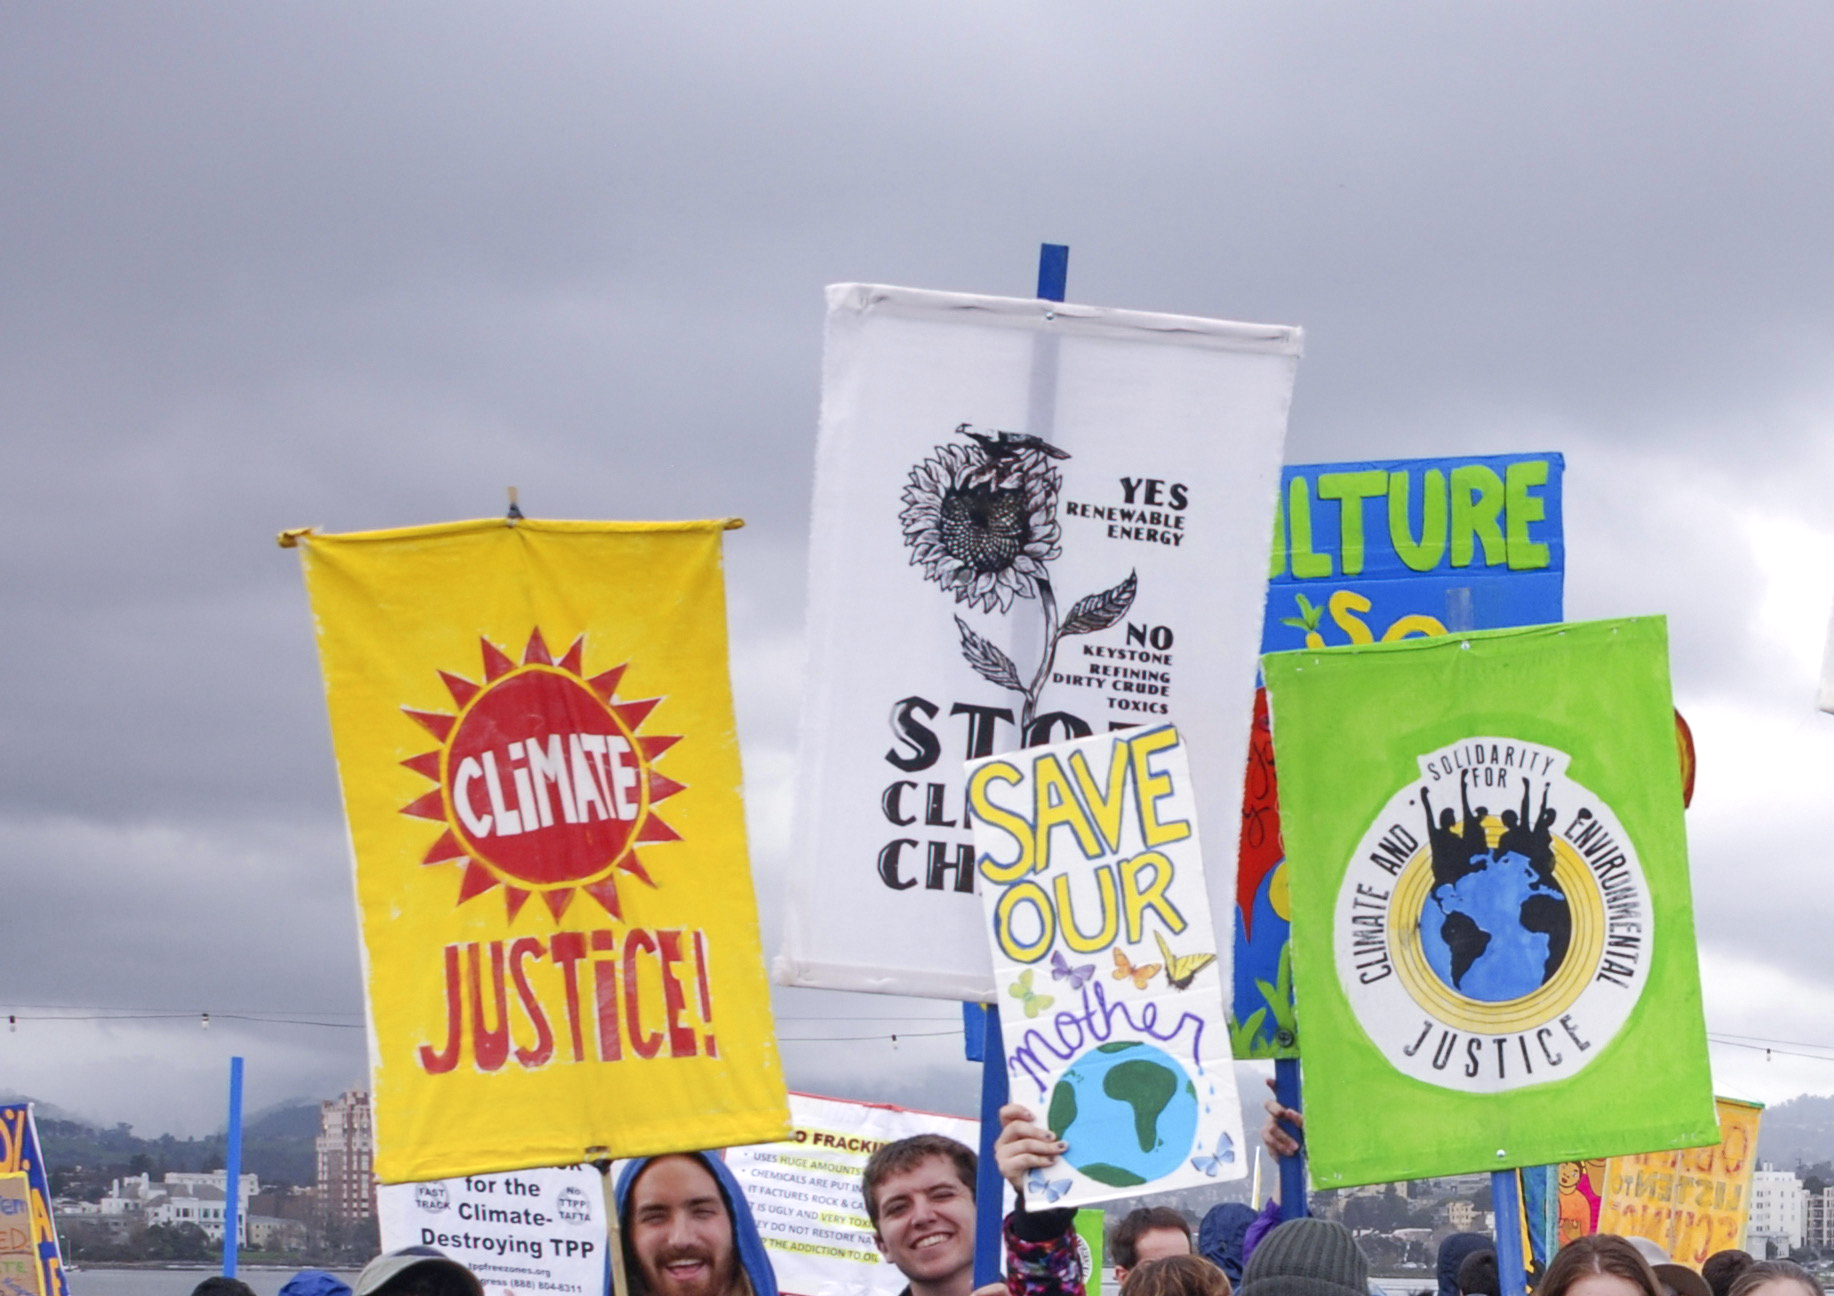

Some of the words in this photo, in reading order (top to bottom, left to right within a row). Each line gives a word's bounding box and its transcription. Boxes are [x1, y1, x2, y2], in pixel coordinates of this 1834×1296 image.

[1120, 477, 1189, 511] YES
[1066, 501, 1186, 530] RENEWABLE
[1107, 525, 1184, 547] ENERGY
[1125, 622, 1174, 651] NO
[1083, 645, 1173, 666] KEYSTONE
[1053, 673, 1104, 688] DIRTY
[1112, 680, 1170, 697] CRUDE
[1090, 664, 1171, 684] REFINING
[1107, 697, 1169, 714] TOXICS
[1428, 744, 1555, 781] SOLIDARITY
[454, 732, 643, 837] CLIMATE
[1472, 767, 1508, 788] FOR
[968, 723, 1191, 885] SAVE
[1371, 823, 1419, 876] AND
[994, 850, 1188, 963] OUR
[1563, 817, 1641, 989] ENVIRONMENTAL
[1351, 883, 1392, 986] CLIMATE
[418, 927, 721, 1074] JUSTICE!
[1009, 980, 1204, 1092] mother
[1403, 1014, 1591, 1079] JUSTICE
[814, 1133, 885, 1153] FRACKI
[754, 1152, 777, 1163] USES
[780, 1156, 807, 1168] HUGE
[810, 1160, 861, 1175] AMOUNTS
[465, 1177, 497, 1193] for
[505, 1178, 541, 1197] the
[751, 1169, 806, 1184] CHEMICALS
[809, 1178, 828, 1188] ARE
[830, 1181, 849, 1190] PUT
[418, 1187, 446, 1197] FAST
[748, 1185, 756, 1193] IT
[760, 1186, 808, 1201] FACTURES
[812, 1195, 838, 1206] ROCK
[416, 1199, 451, 1210] TRACK
[458, 1203, 553, 1226] Climate-
[758, 1202, 765, 1212] IS
[768, 1205, 793, 1216] UGLY
[796, 1209, 818, 1220] AND
[821, 1213, 846, 1224] VERY
[421, 1228, 543, 1259] Destroying
[550, 1238, 595, 1258] TPP
[771, 1222, 785, 1231] DO
[788, 1225, 809, 1235] NOT
[812, 1228, 855, 1242] RESTORE
[770, 1239, 788, 1249] THE
[790, 1242, 845, 1258] ADDICTION
[848, 1250, 861, 1260] TO
[863, 1252, 879, 1263] OIL
